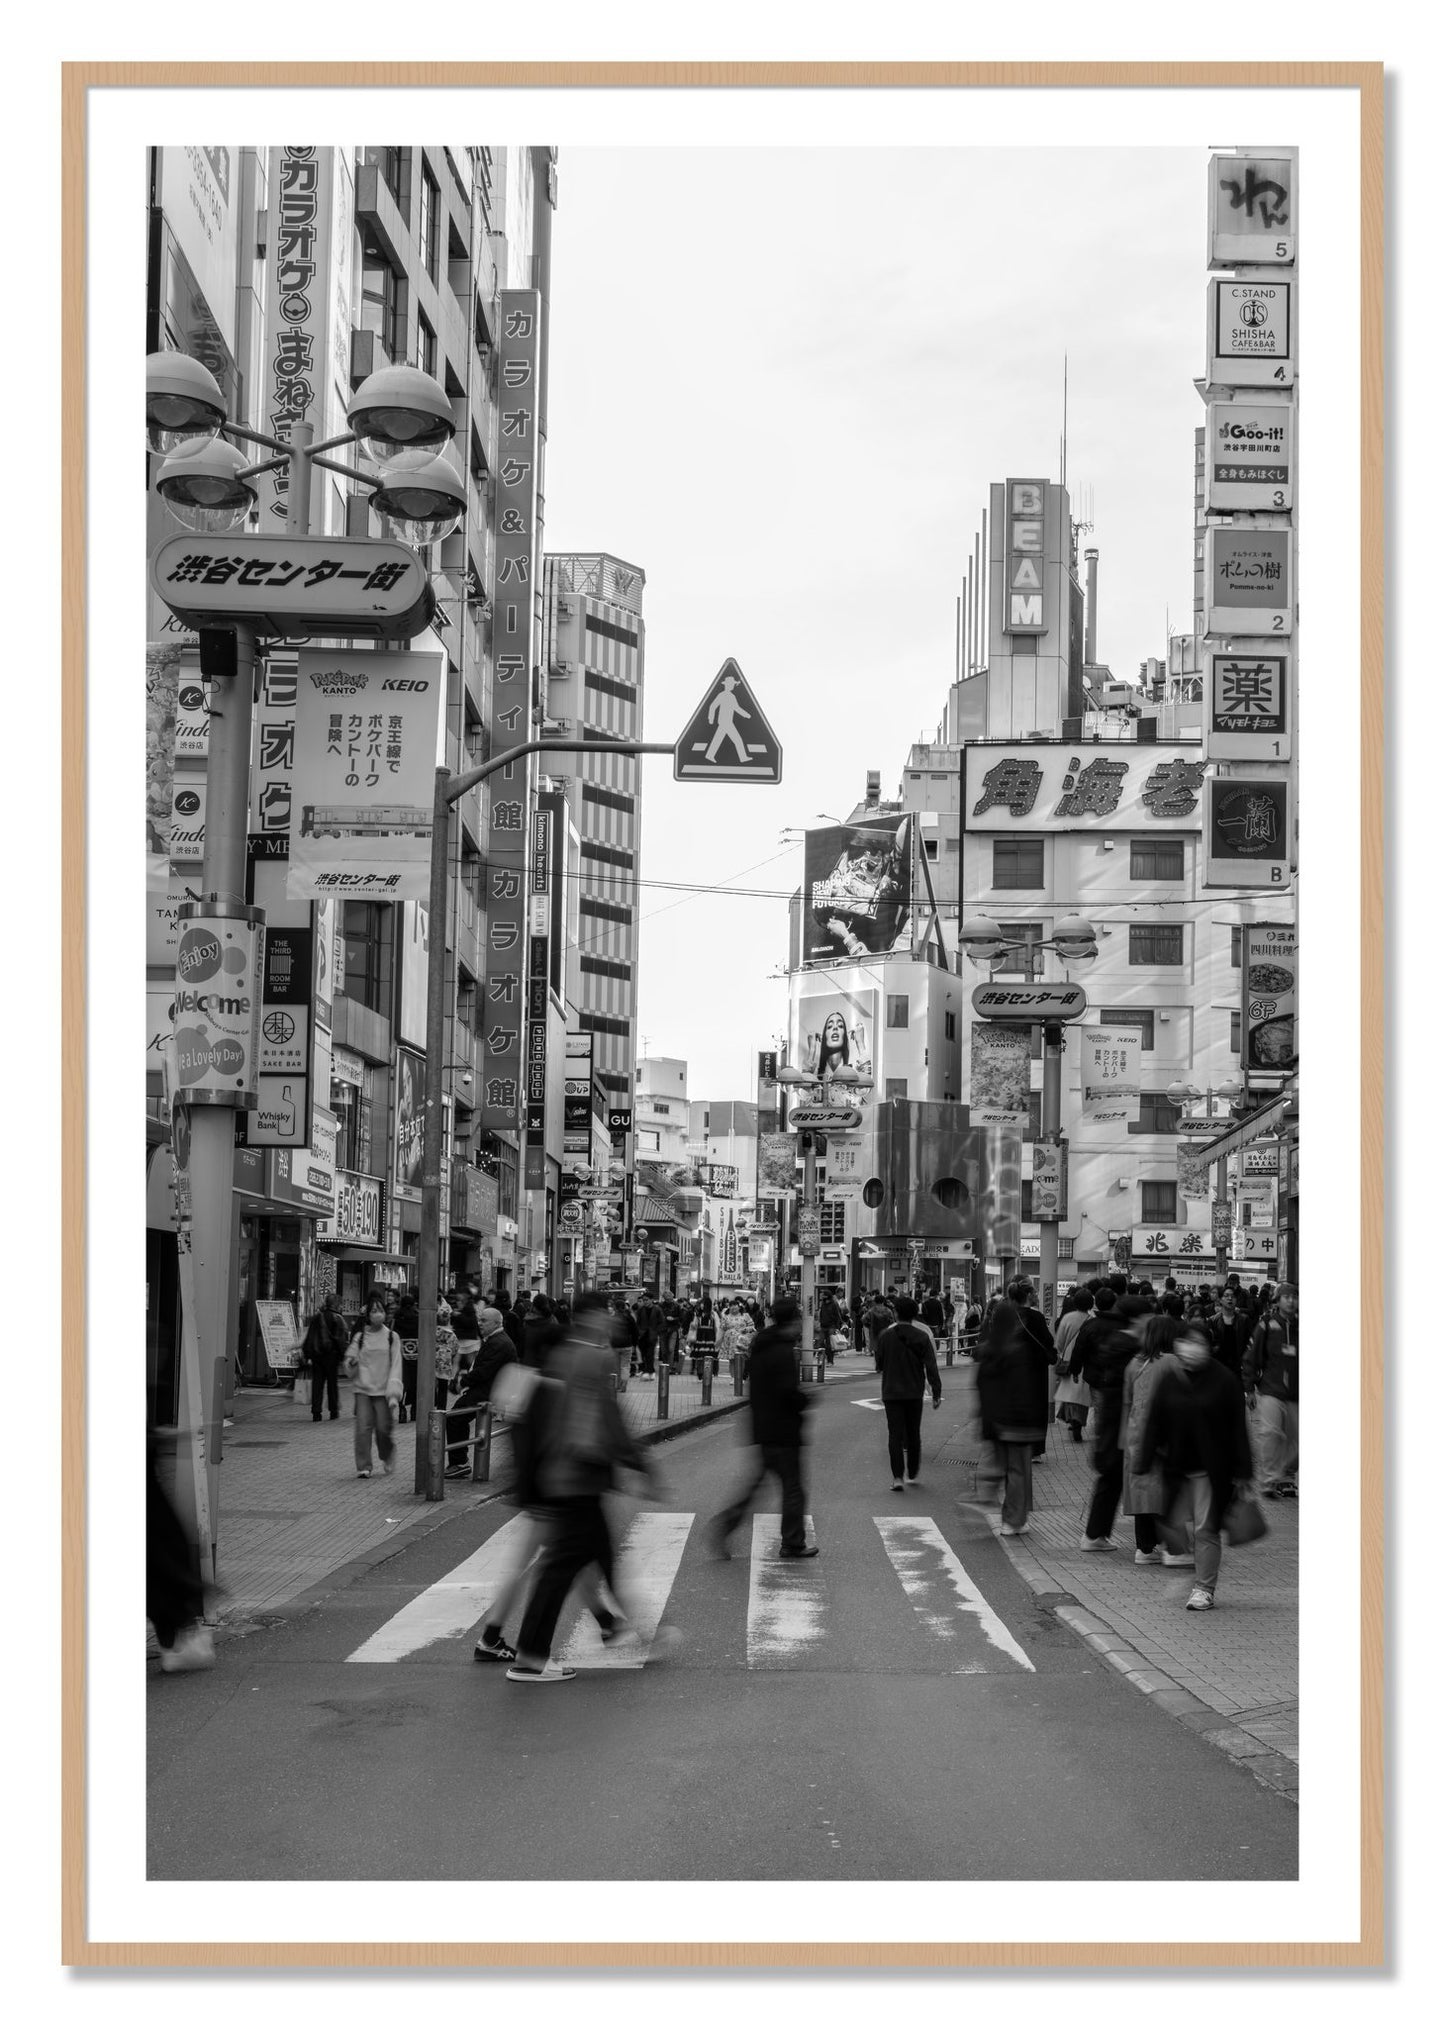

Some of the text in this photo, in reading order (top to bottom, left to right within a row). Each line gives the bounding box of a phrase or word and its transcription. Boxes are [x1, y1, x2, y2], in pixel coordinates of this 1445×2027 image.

[278, 159, 319, 294] カラオケ
[1276, 242, 1287, 257] 5
[1232, 289, 1276, 299] C.STAND
[1232, 328, 1276, 339] SHISHA
[1232, 340, 1276, 348] CAFE&BAR
[1230, 424, 1284, 440] Goo-it!
[1224, 443, 1281, 453] 渋谷宇田川町店
[1219, 467, 1285, 480] 全身もみほぐし
[1273, 491, 1285, 506] 3
[1011, 483, 1042, 625] BEAM
[166, 554, 411, 591] 渋谷センター街
[1229, 583, 1275, 591] Pomme-no-ki
[1273, 616, 1285, 631] 2
[381, 679, 429, 692] KEIO
[1222, 662, 1273, 713] 薬
[1217, 714, 1278, 730] マツモトキヨシ
[327, 713, 343, 756] 冒険へ
[179, 741, 203, 750] 渋谷店
[345, 713, 363, 786] カントーの
[386, 714, 404, 774] 京王線で
[1272, 741, 1281, 756] 1
[972, 757, 1208, 816] 角海老
[176, 846, 200, 855] 渋谷店
[536, 815, 547, 889] kimono hearts
[314, 873, 402, 886] 渋谷センター街
[1271, 867, 1283, 882] B
[1250, 944, 1294, 957] 四川料理
[179, 941, 219, 976] Enjoy
[269, 975, 291, 983] ROOM
[273, 985, 287, 993] BAR
[175, 989, 251, 1015] Welcome
[979, 992, 1080, 1005] 渋谷センター街
[1249, 1000, 1277, 1021] 6F
[192, 1047, 222, 1067] Lovely
[223, 1048, 243, 1063] Day!
[258, 1111, 291, 1124] Whisky
[610, 1115, 630, 1126] GU
[793, 1111, 854, 1121] 渋谷センター街
[257, 1120, 278, 1130] Bank
